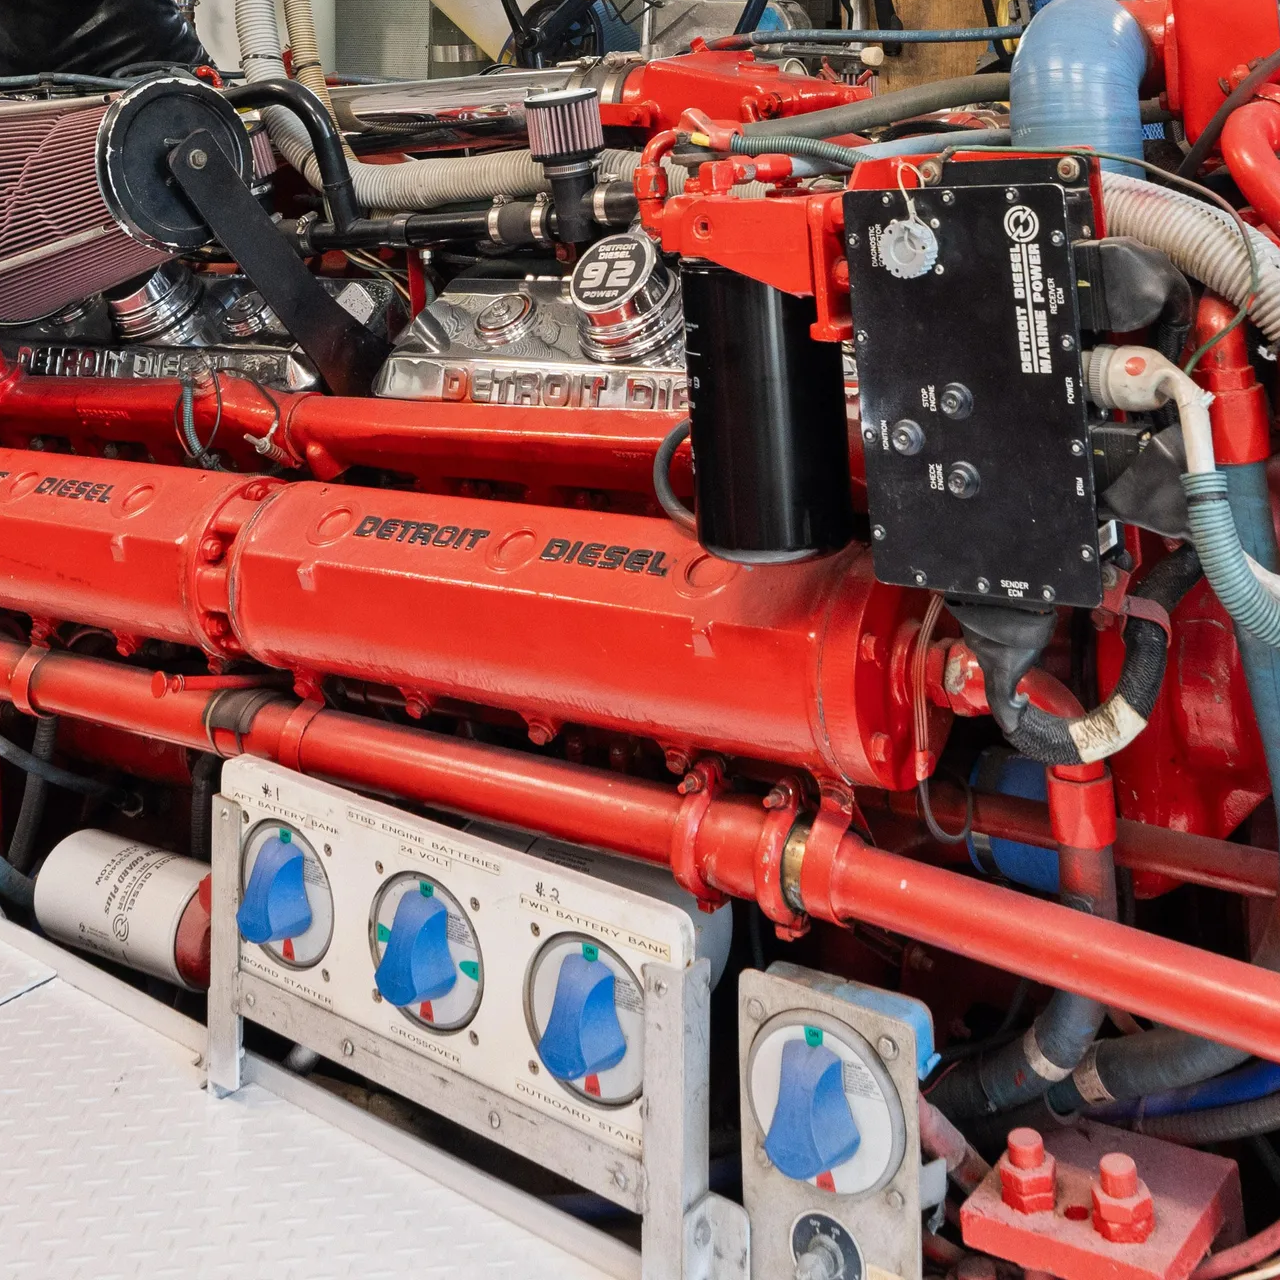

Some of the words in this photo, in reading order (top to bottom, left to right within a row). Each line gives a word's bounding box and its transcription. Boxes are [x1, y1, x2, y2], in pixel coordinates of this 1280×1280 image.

[598, 242, 638, 252] DETROIT
[598, 250, 631, 260] DIESEL
[868, 226, 878, 267] DIAGNOSTIC
[579, 260, 636, 288] 92
[1010, 244, 1026, 299] DIESEL
[1030, 244, 1045, 302] POWER
[582, 290, 619, 298] POWER
[1048, 278, 1057, 314] RECEIVER
[1016, 307, 1032, 374] DETROIT
[1034, 310, 1052, 374] MARINE
[442, 366, 608, 408] DETROIT
[929, 385, 937, 412] ENGINE
[1064, 377, 1074, 404] POWER
[880, 420, 889, 450] IGNITION
[34, 476, 114, 504] DIESEL
[937, 464, 945, 490] ENGINE
[1076, 477, 1084, 496] ERIM
[354, 516, 490, 551] DETROIT
[539, 538, 668, 576] DIESEL
[1000, 580, 1029, 590] SENDER
[1008, 589, 1024, 598] ECM
[234, 792, 253, 802] AFT
[258, 800, 306, 822] BATTERY
[348, 811, 376, 826] STBD
[382, 823, 424, 845] ENGINE
[432, 842, 500, 872] BATTERIES
[95, 858, 116, 886] FLOW
[118, 857, 144, 884] GUARD
[136, 862, 150, 874] OIL
[420, 851, 450, 868] VOLT
[118, 876, 137, 910] FILTER
[127, 872, 152, 912] DIESEL
[520, 897, 549, 914] FWD
[556, 910, 620, 938] BATTERY
[628, 934, 668, 957] BANK
[586, 946, 595, 956] ON
[284, 976, 332, 1004] STARTER
[390, 1024, 460, 1064] CROSSOVER
[808, 1030, 820, 1039] ON
[516, 1082, 591, 1122] OUTBOARD
